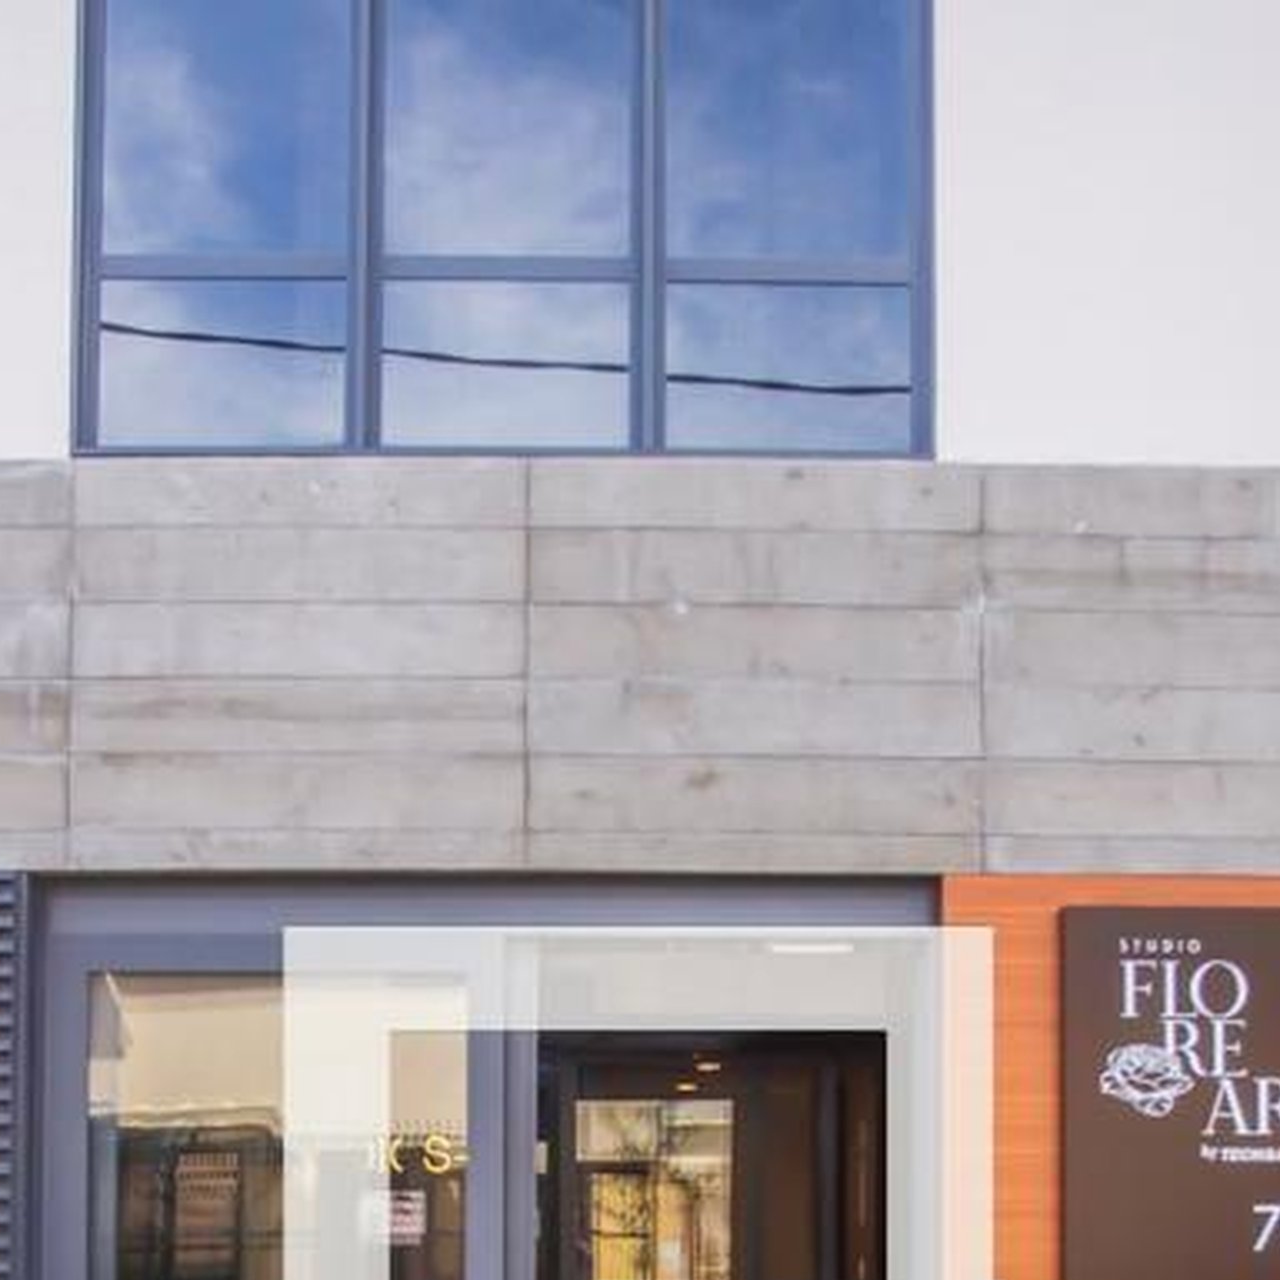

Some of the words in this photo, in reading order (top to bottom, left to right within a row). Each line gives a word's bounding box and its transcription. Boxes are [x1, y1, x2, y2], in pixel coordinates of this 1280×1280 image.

[1119, 937, 1201, 954] STUDIO
[1120, 959, 1249, 1019] FLO
[1158, 1018, 1249, 1078] RE
